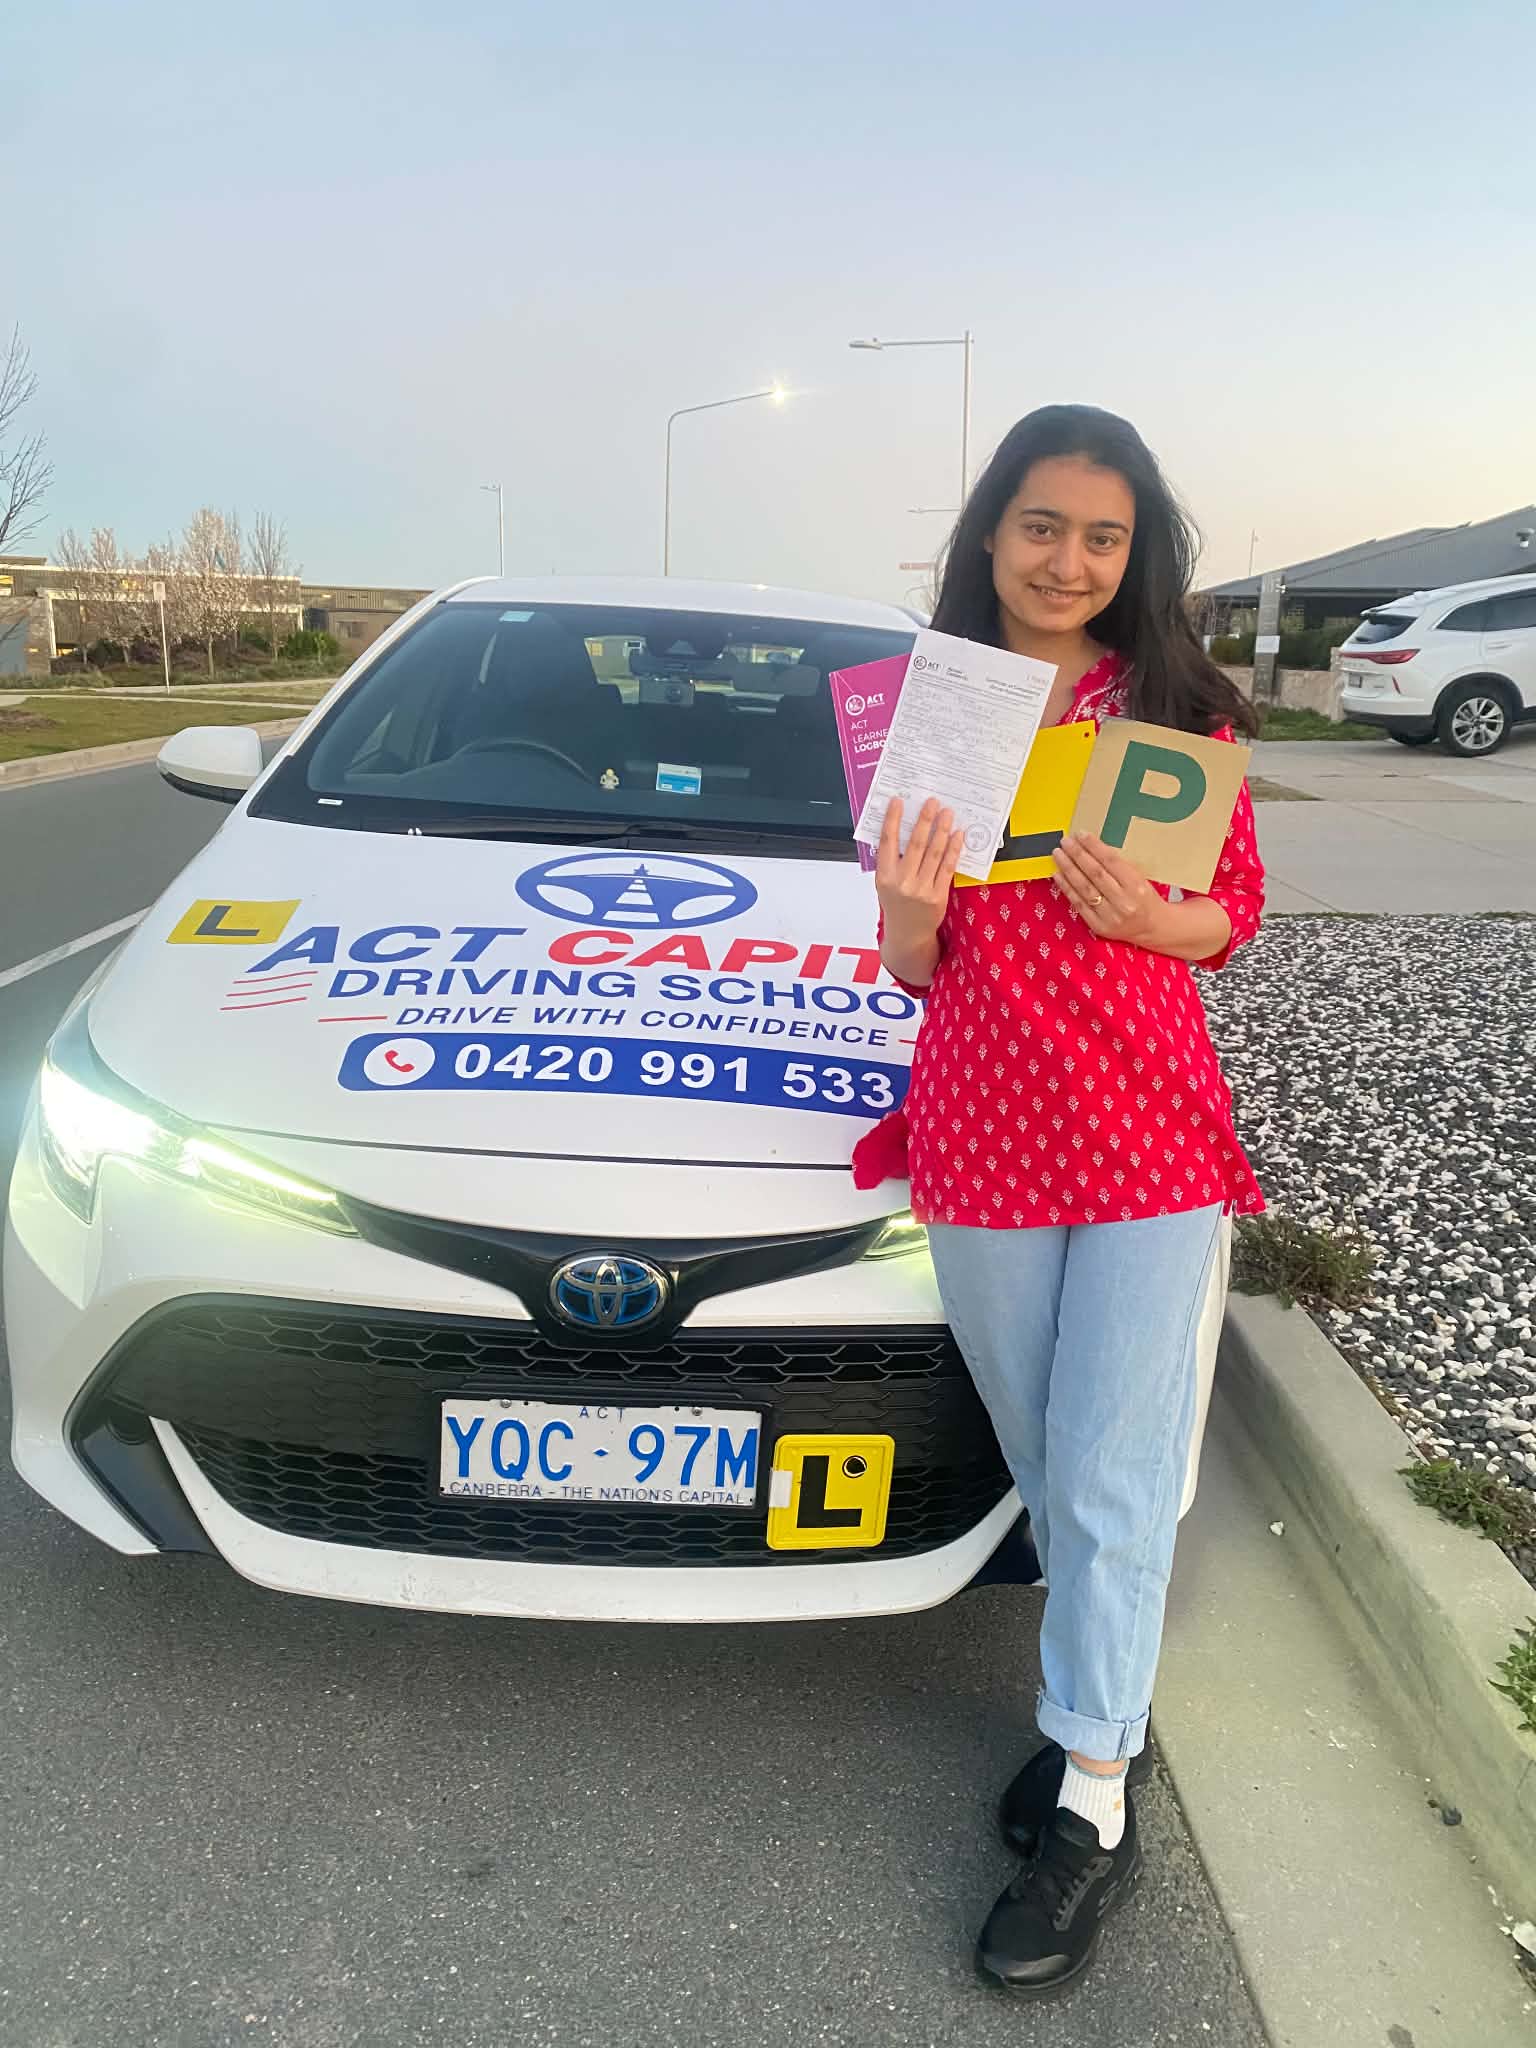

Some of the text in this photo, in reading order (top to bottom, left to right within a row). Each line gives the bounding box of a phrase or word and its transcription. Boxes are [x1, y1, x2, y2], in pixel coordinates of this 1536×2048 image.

[867, 693, 884, 705] ACT
[851, 720, 867, 730] ACT
[853, 729, 889, 744] LEARNE
[854, 740, 887, 753] LOGBO
[1100, 740, 1207, 849] P
[195, 905, 260, 936] L
[245, 925, 906, 985] ACT CAPIT
[327, 969, 926, 1020] DRIVING SCHOO
[396, 1007, 889, 1047] DRIVE WITH CONFIDENCE
[454, 1043, 895, 1109] 0420 991 533
[446, 1415, 758, 1488] YQC 97M
[450, 1481, 542, 1497] CANBERRA
[561, 1486, 593, 1499] THE
[679, 1490, 744, 1504] CAPITAL
[796, 1455, 863, 1528] L
